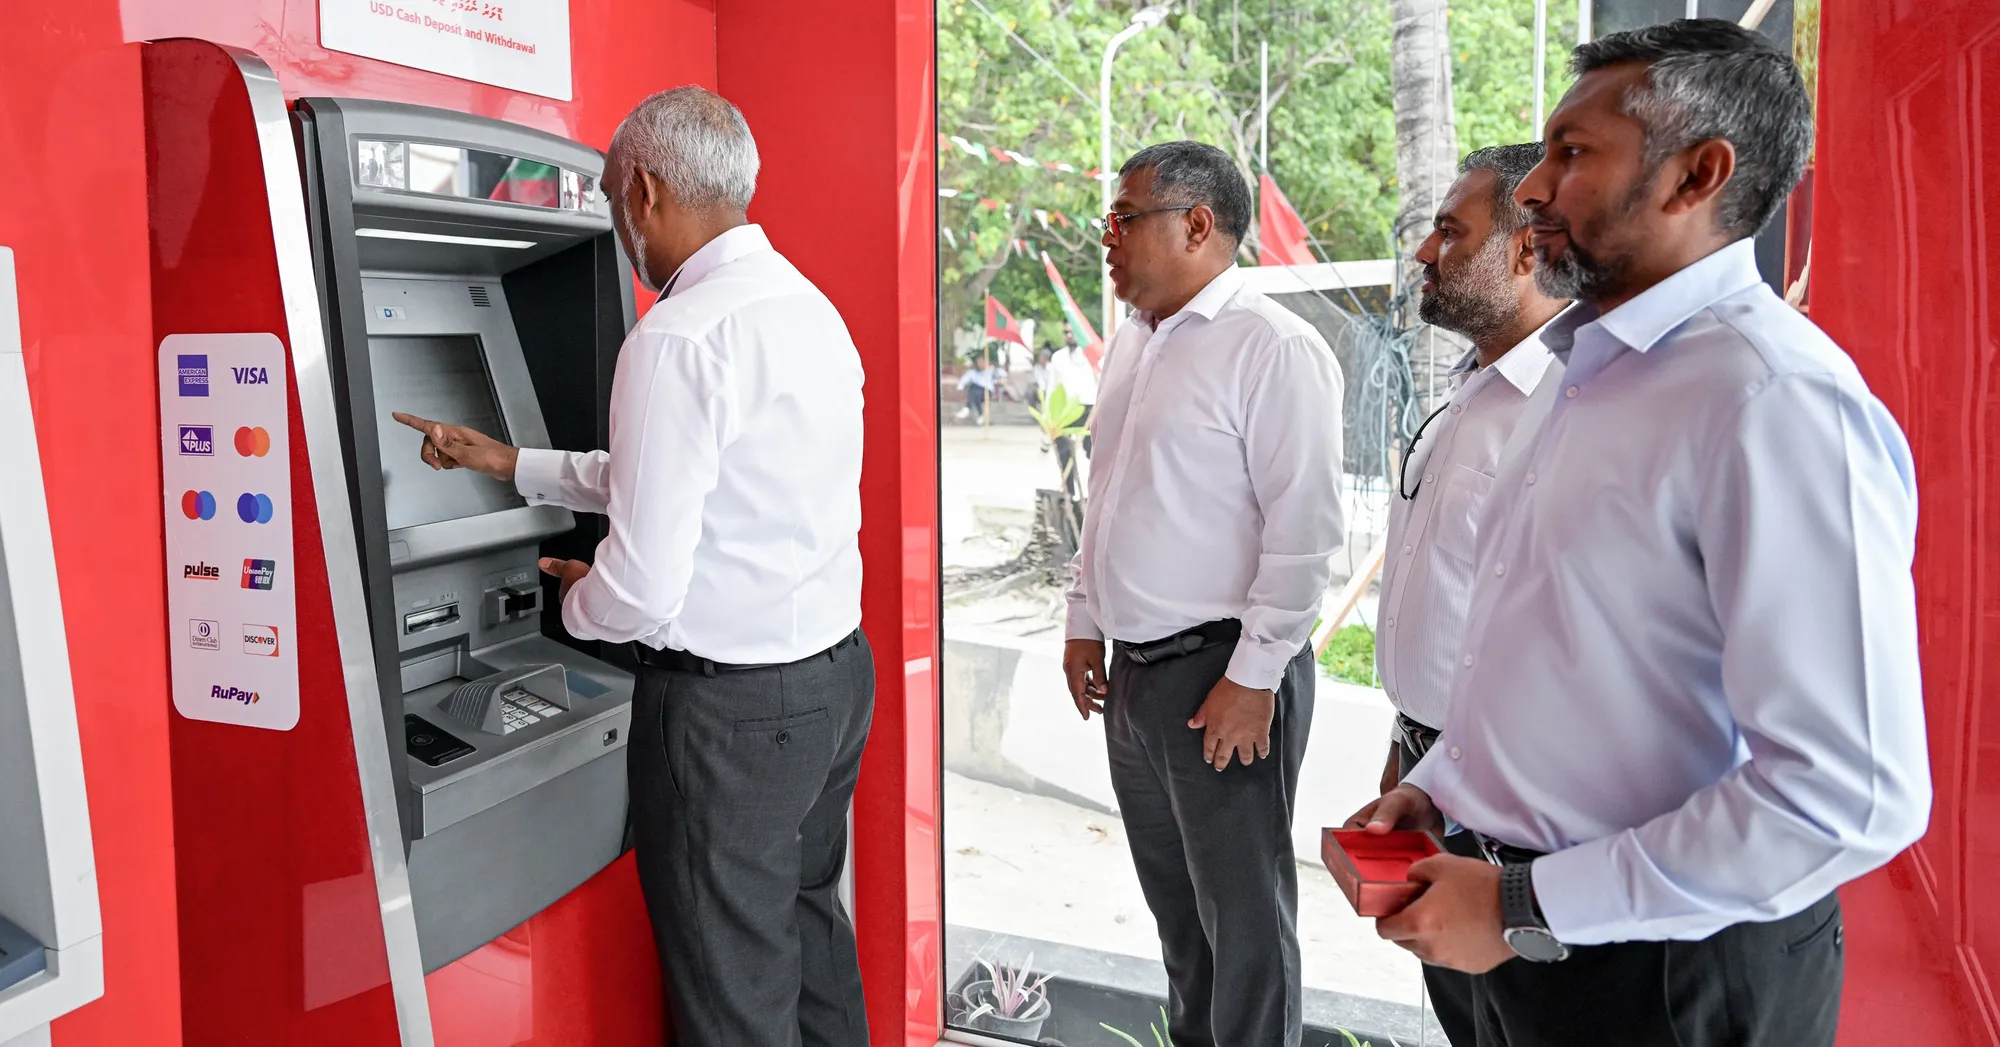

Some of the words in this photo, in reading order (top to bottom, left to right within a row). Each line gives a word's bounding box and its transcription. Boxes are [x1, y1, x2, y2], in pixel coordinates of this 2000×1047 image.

[370, 0, 393, 17] USD
[397, 8, 421, 25] Cash
[424, 16, 462, 36] Deposit
[464, 28, 482, 41] and
[485, 31, 536, 55] Withdrawal
[178, 368, 206, 376] AMERICAN
[231, 367, 268, 384] VISA
[190, 440, 211, 452] PLUS
[184, 561, 219, 578] pulse
[244, 565, 273, 579] UnionPay
[245, 635, 275, 645] DISCOVER
[211, 685, 254, 705] RuPay
